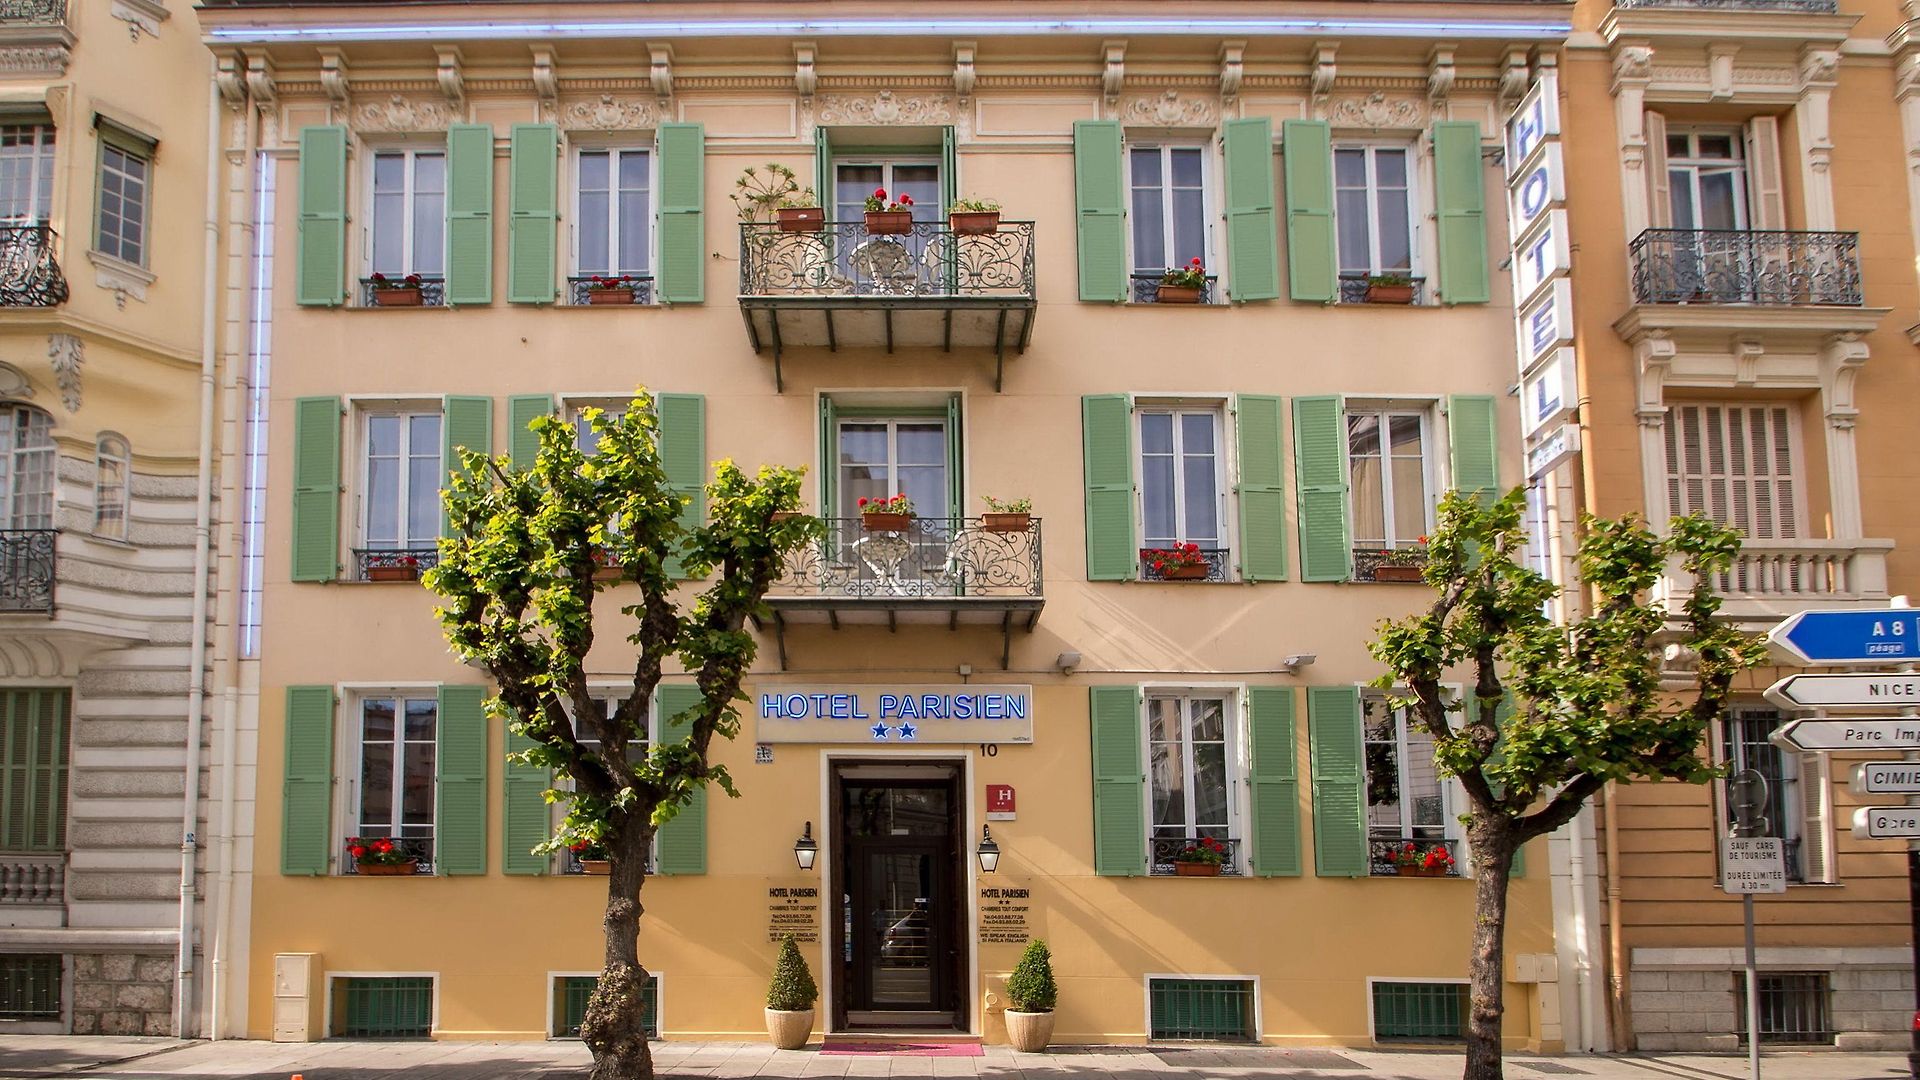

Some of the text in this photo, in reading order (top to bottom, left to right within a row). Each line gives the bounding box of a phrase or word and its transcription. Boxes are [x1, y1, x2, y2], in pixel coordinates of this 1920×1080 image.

[1516, 96, 1560, 422] HOTEL
[1872, 621, 1904, 636] A 8
[1869, 644, 1901, 654] péage
[762, 694, 1025, 719] HOTEL PARISIEN
[1844, 729, 1881, 740] Parc
[980, 743, 998, 757] 10
[999, 789, 1012, 801] H
[1731, 842, 1774, 850] SAUF CARS
[1729, 852, 1777, 860] DE TOURISME
[769, 888, 817, 897] HOTEL PARISIEN
[981, 889, 1029, 898] HOTEL PARISIEN
